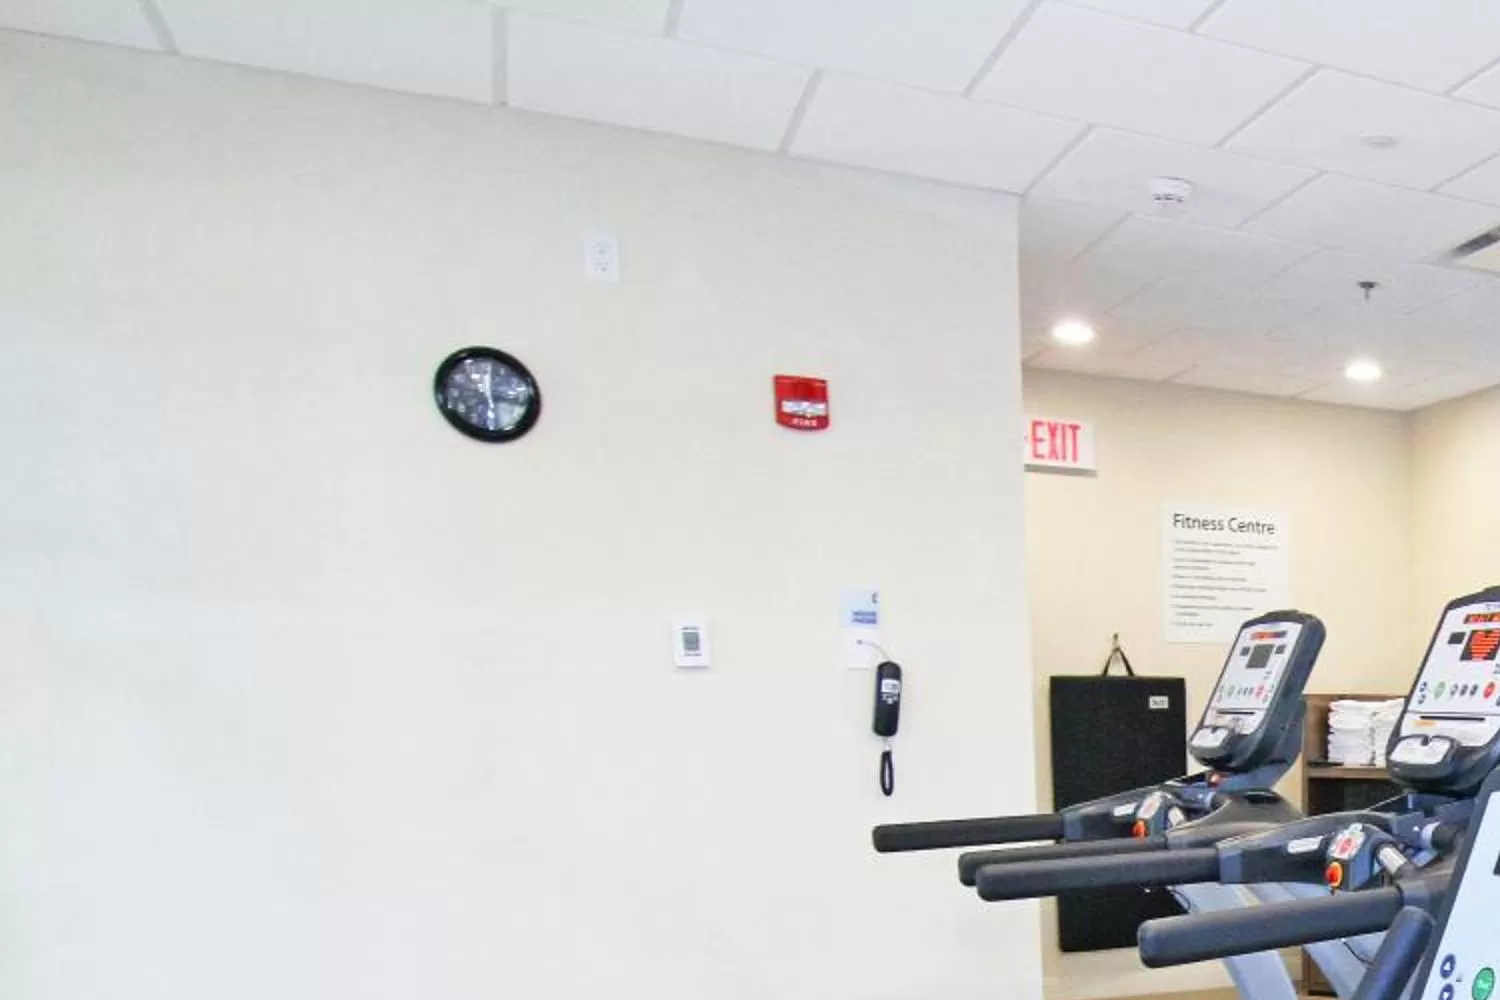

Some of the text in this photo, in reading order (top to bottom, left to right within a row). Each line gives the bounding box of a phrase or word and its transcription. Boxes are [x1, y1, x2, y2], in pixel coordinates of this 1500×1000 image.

[1031, 419, 1081, 463] EXIT
[1173, 513, 1275, 535] Fitness Centre
